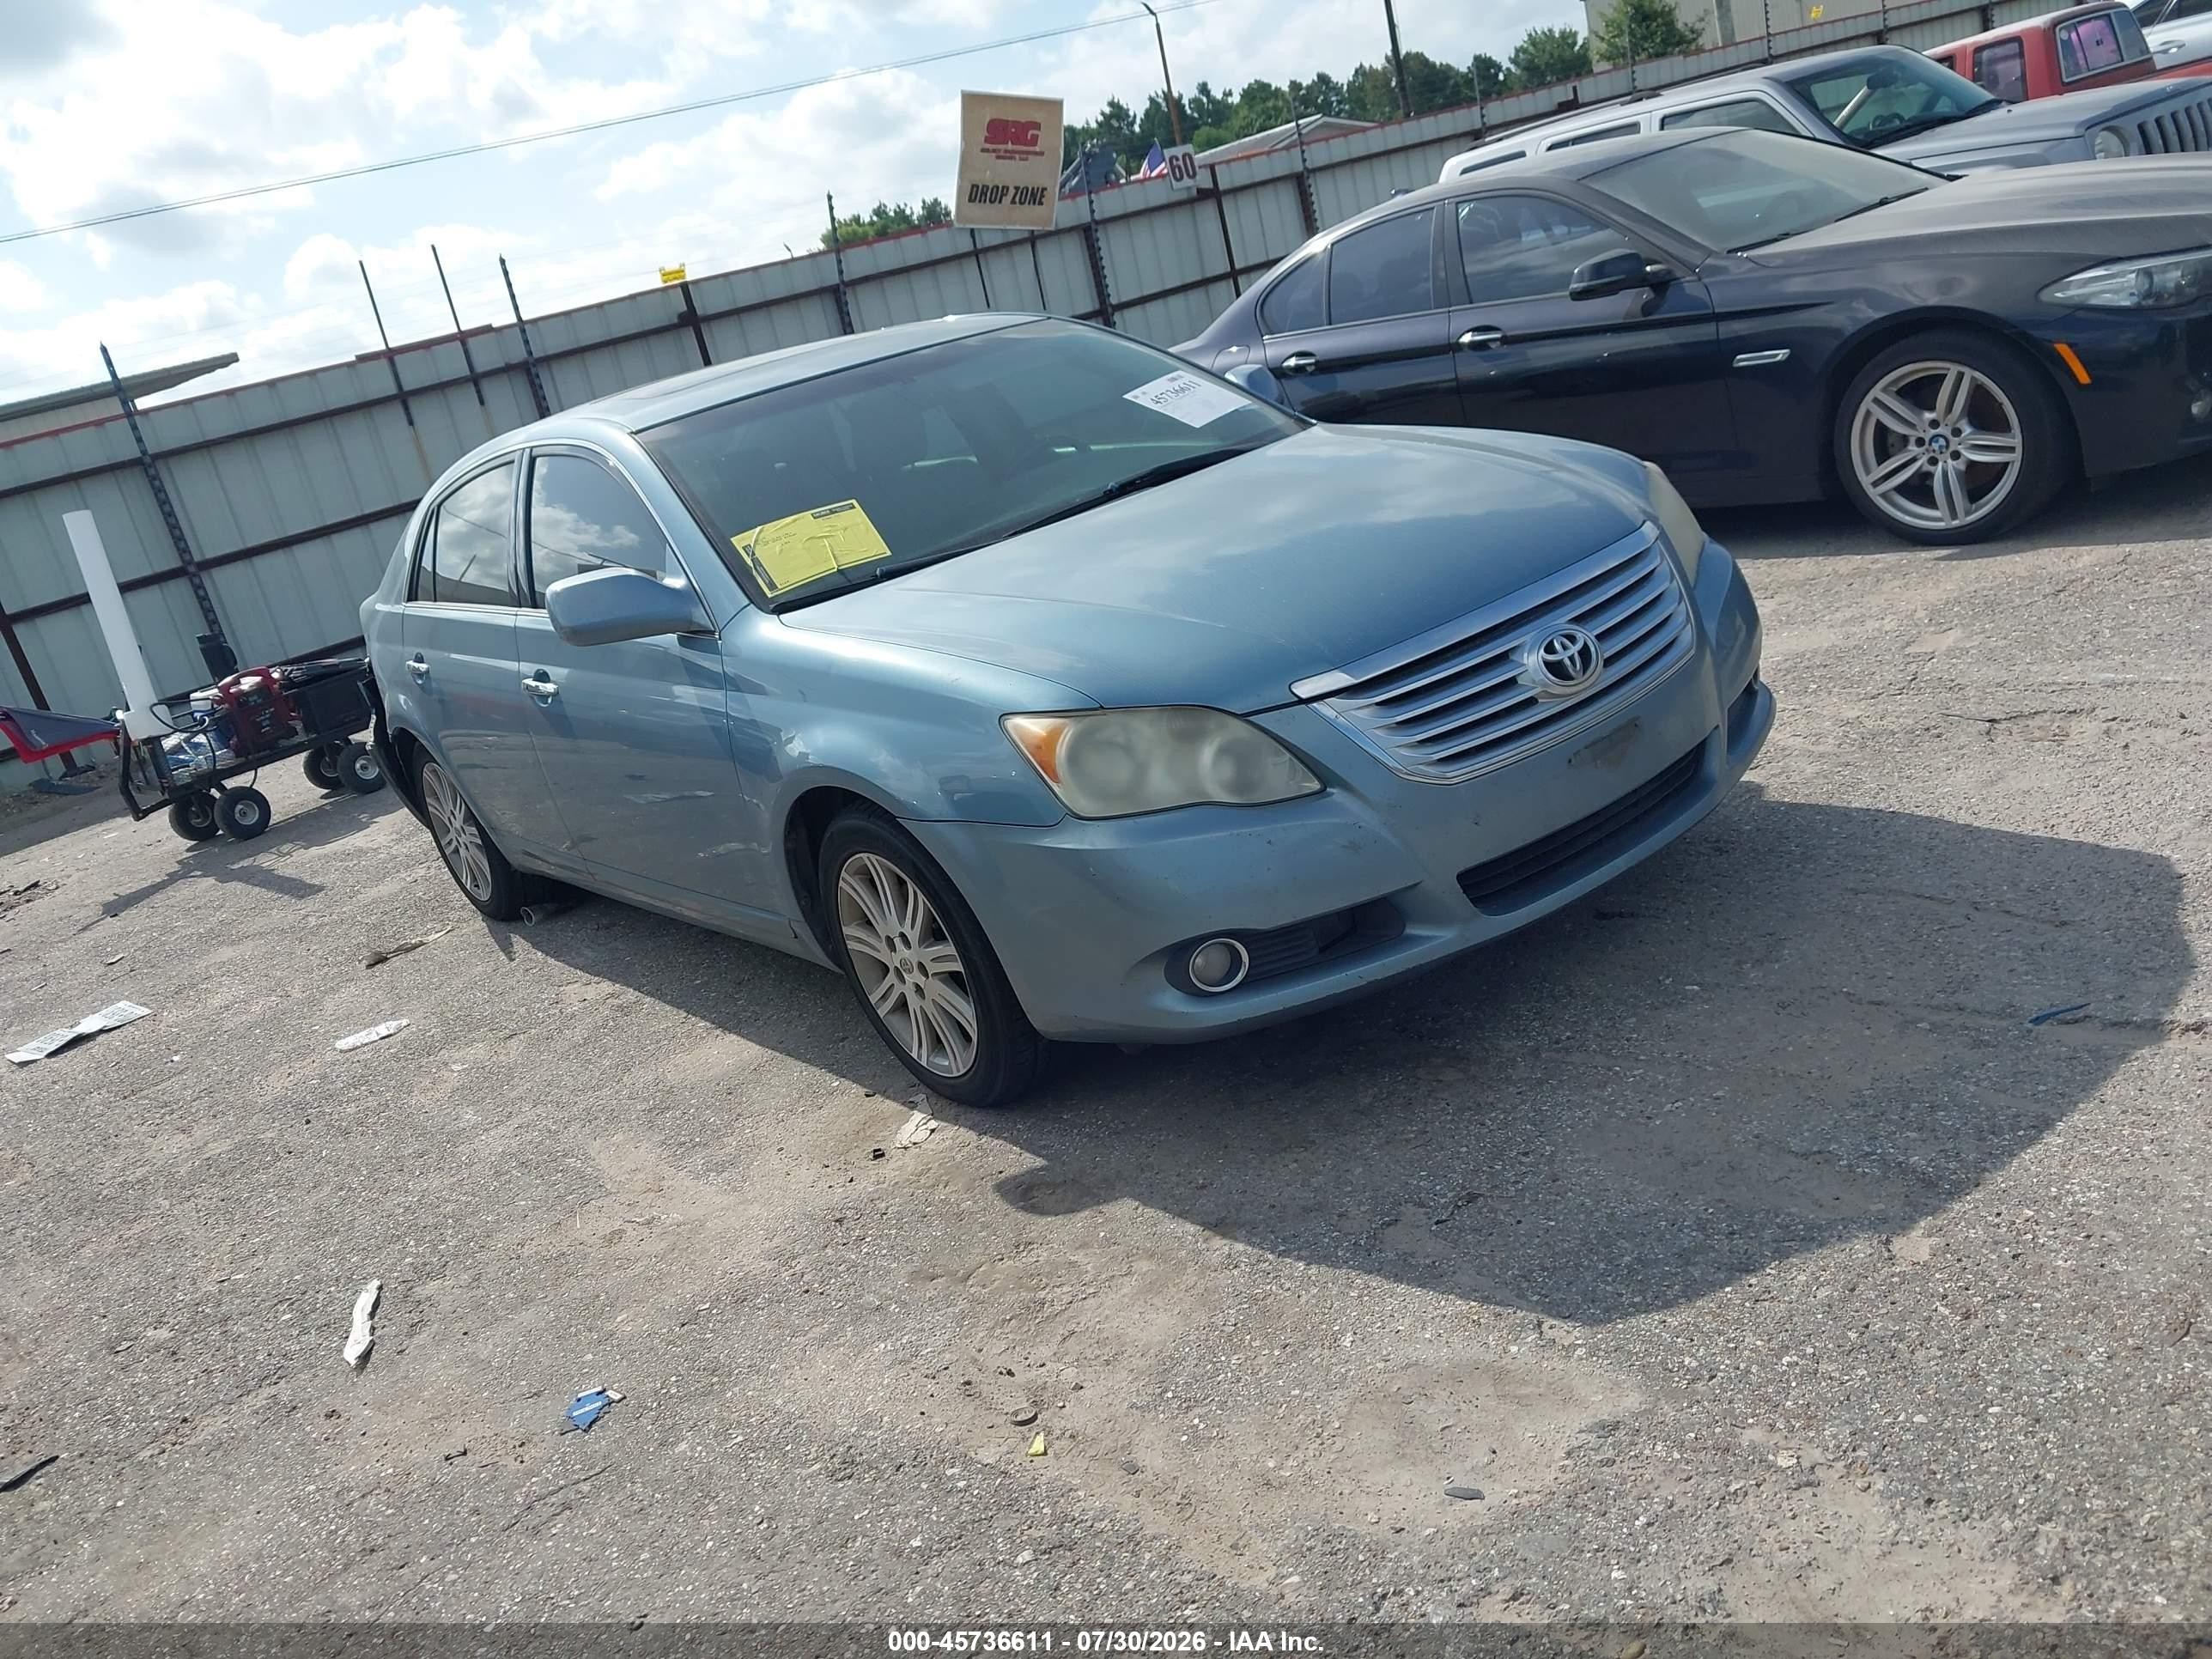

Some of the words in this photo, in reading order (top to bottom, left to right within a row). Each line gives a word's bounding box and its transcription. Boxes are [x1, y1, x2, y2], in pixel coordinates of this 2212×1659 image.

[983, 118, 1042, 148] SRG
[1169, 152, 1197, 182] 60
[968, 183, 1010, 204] DROP
[1010, 185, 1047, 206] ZONE
[1150, 380, 1202, 404] 45736611
